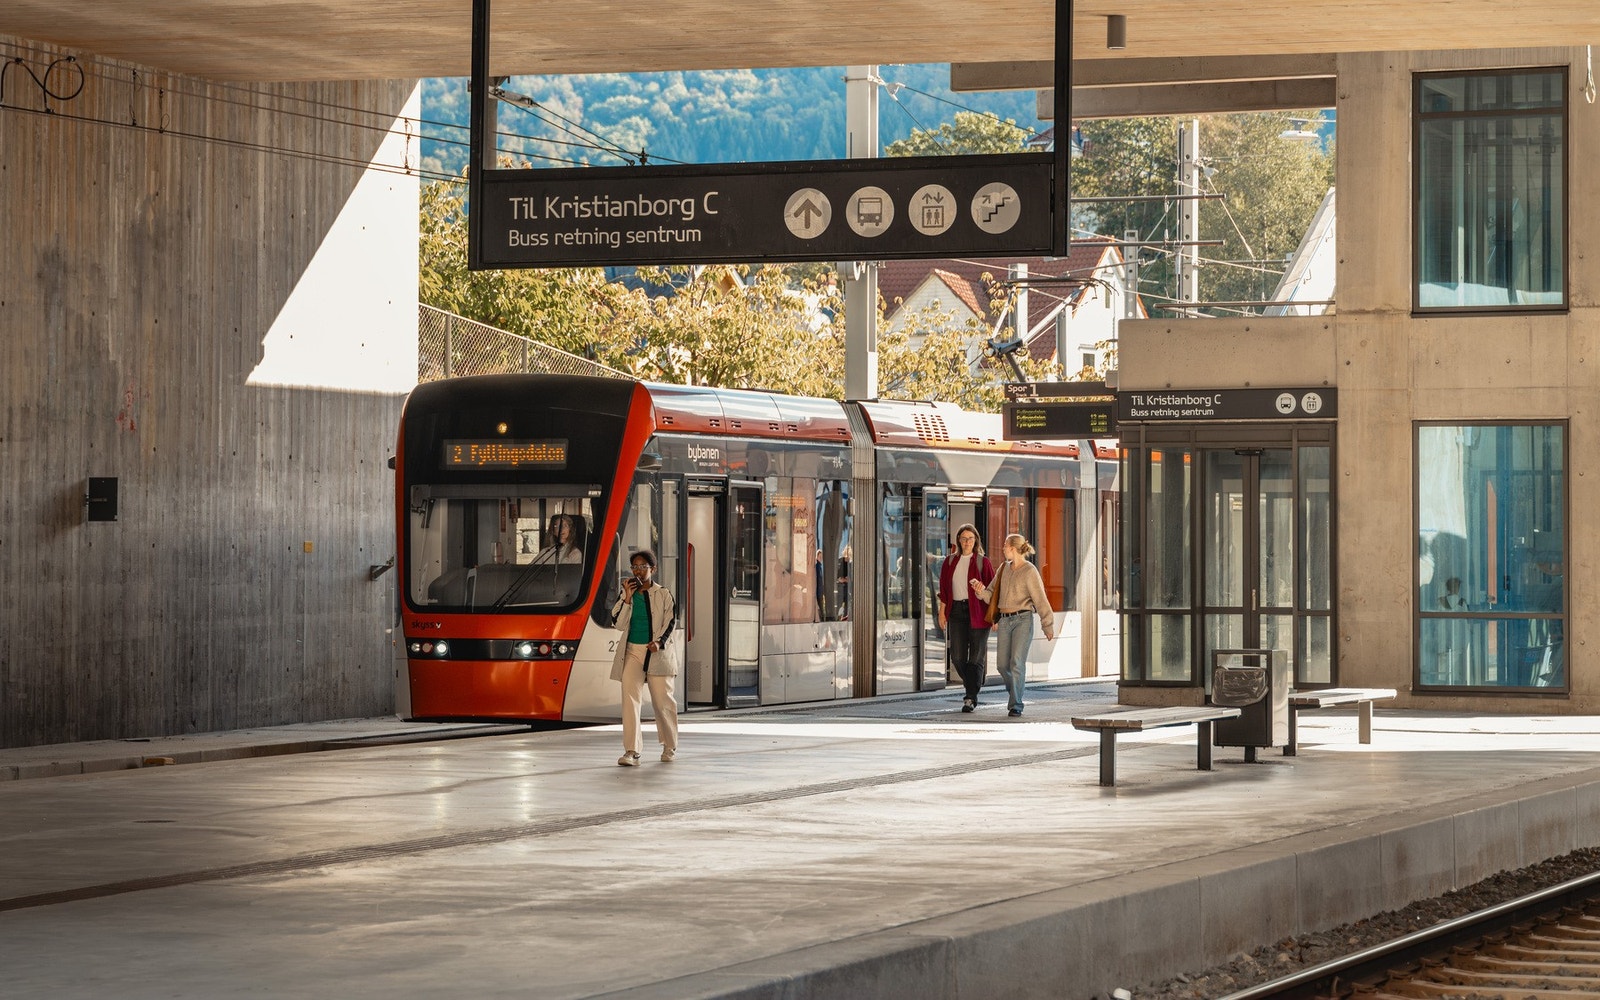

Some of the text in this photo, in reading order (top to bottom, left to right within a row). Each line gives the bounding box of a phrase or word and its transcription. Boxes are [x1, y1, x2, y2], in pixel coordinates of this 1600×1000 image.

[509, 191, 719, 221] Til Kristianborg C
[509, 225, 702, 249] Buss retning sentrum
[1007, 383, 1039, 397] Spor 1
[1131, 394, 1222, 407] Til Kristianborg C
[1131, 407, 1215, 418] Buss retning sentrum
[453, 443, 565, 466] 2 Fyllingsdalen
[687, 443, 720, 462] bybanen
